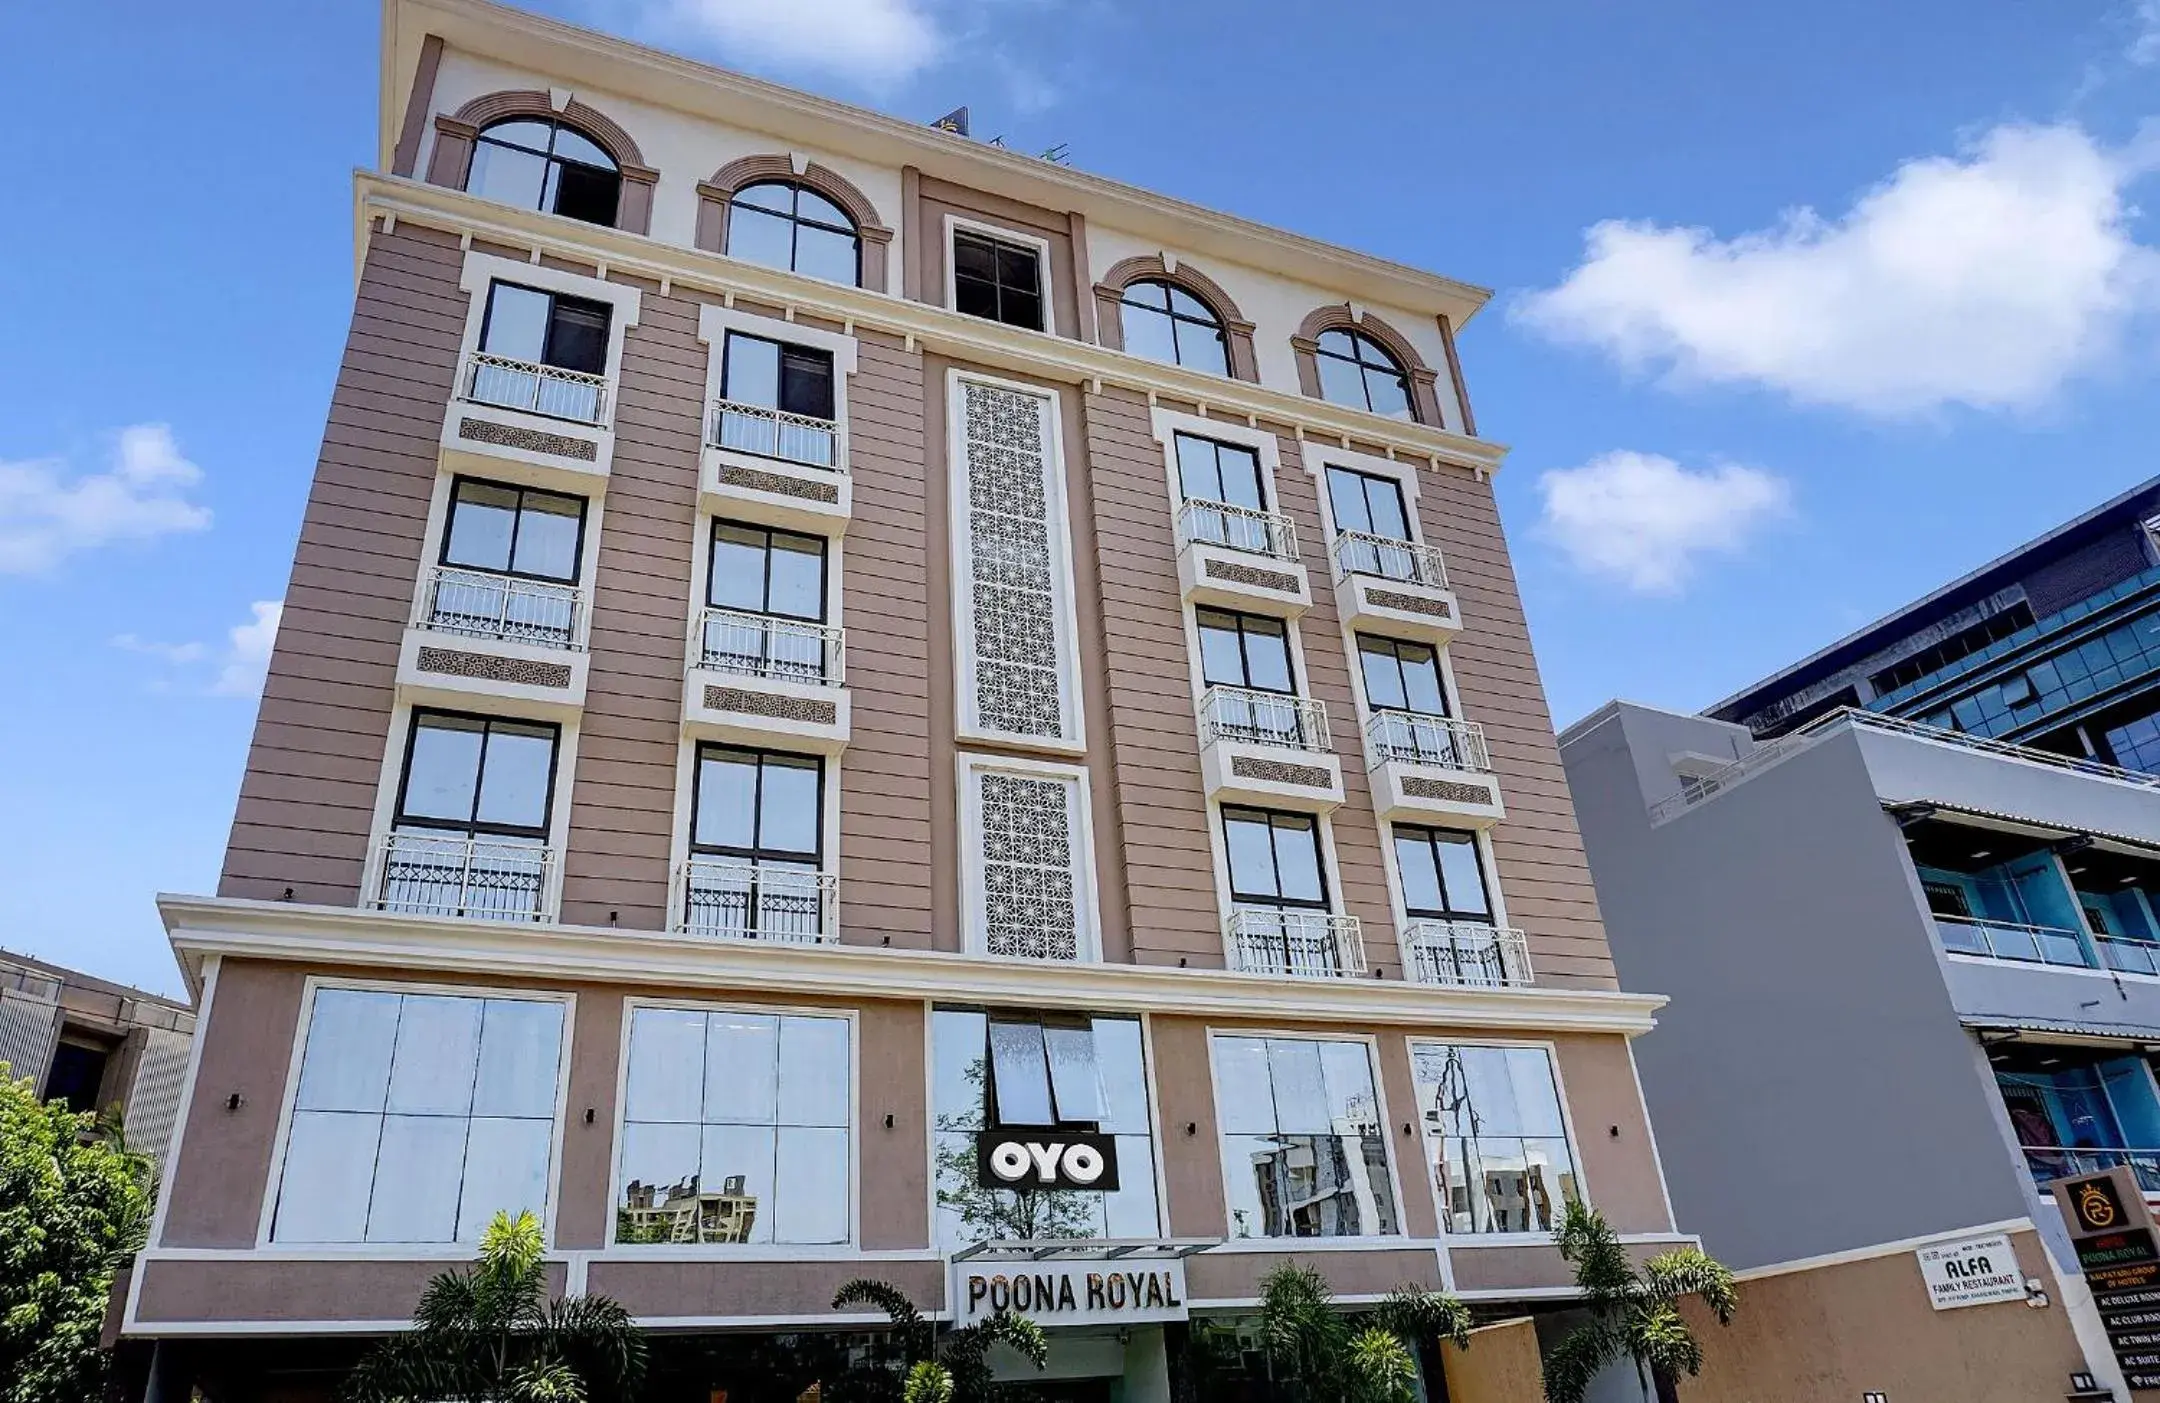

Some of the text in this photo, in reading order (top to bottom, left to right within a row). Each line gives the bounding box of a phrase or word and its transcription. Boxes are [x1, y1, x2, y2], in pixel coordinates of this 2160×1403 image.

[990, 1141, 1104, 1184] OYO
[1945, 1256, 1993, 1279] ALFA
[968, 1271, 1182, 1313] POONA ROYAL
[1932, 1282, 1961, 1295] FAMILY
[1963, 1274, 2015, 1291] RESTAURANT
[2111, 1294, 2140, 1305] DELUXE
[2122, 1315, 2143, 1325] CLUB
